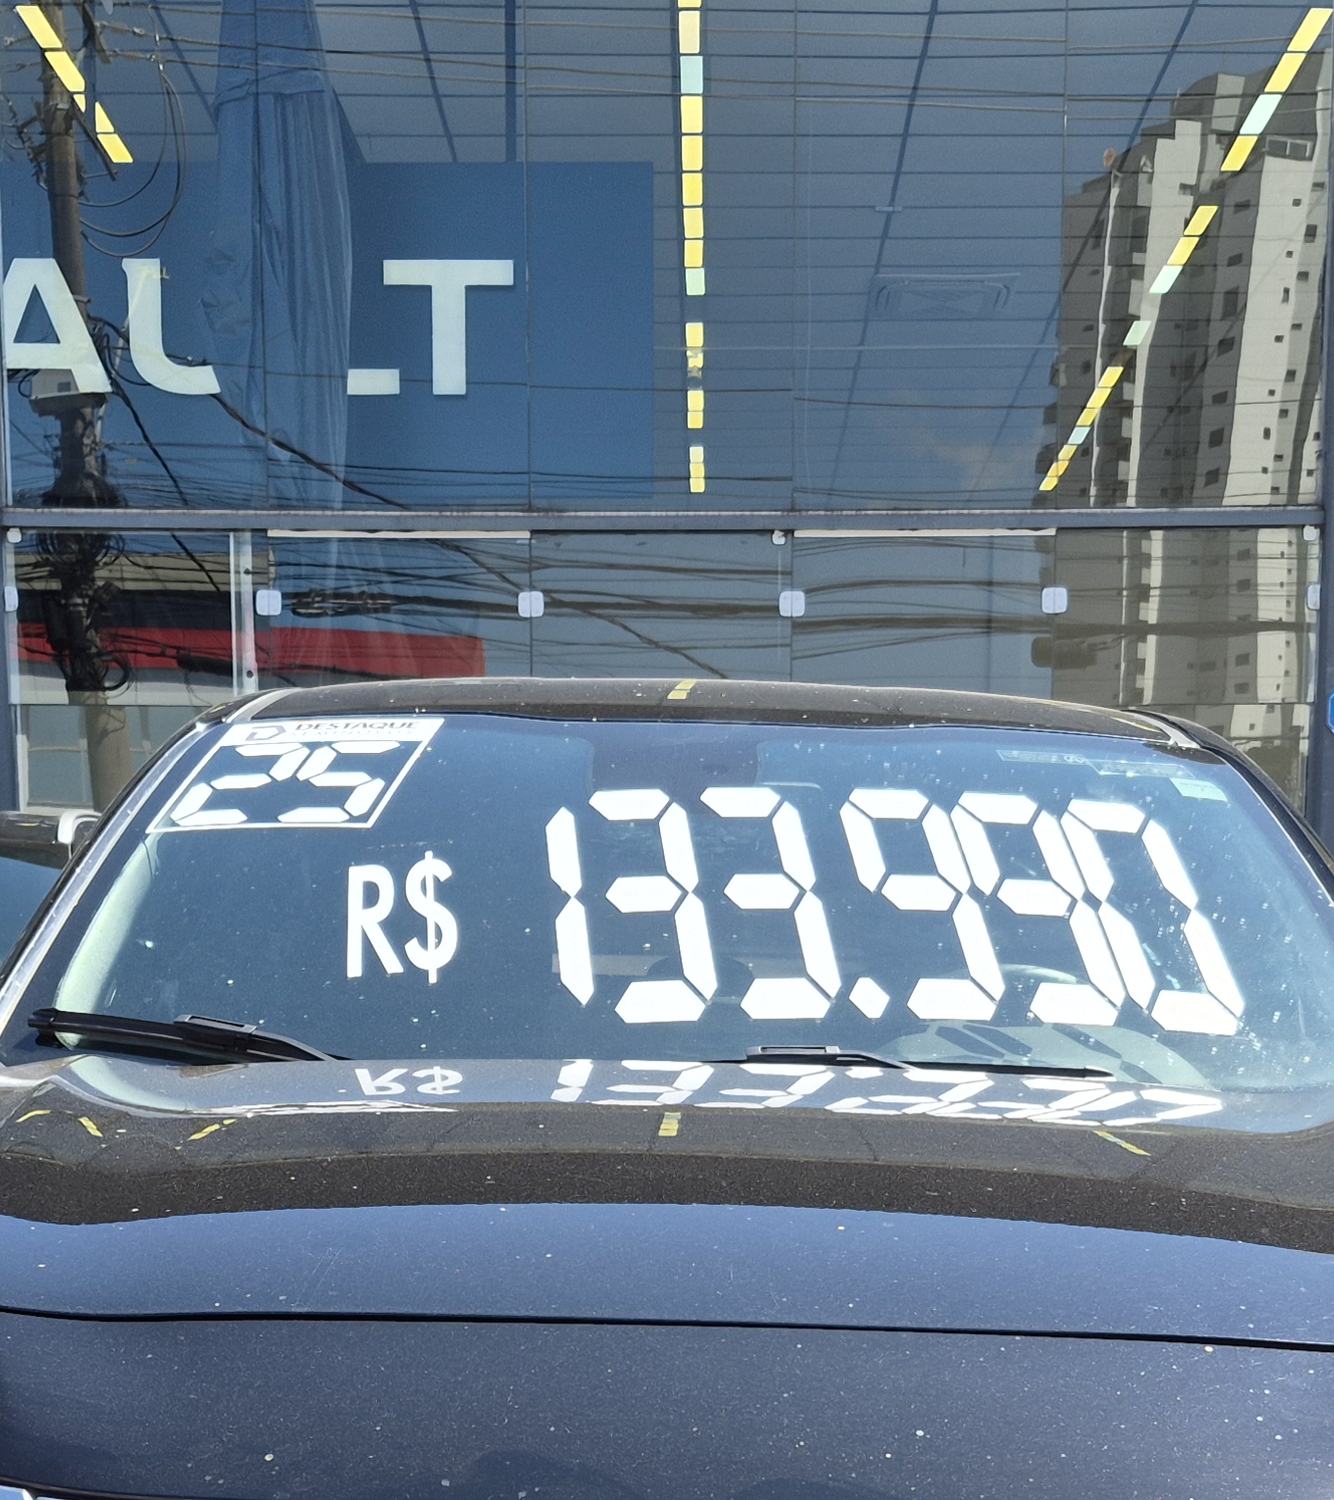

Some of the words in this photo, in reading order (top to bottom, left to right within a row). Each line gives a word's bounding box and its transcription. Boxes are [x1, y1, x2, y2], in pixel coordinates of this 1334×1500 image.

[295, 721, 419, 731] DESTAQUE
[170, 740, 401, 826] 25
[346, 850, 459, 984] R$
[545, 786, 1246, 1037] 133.990
